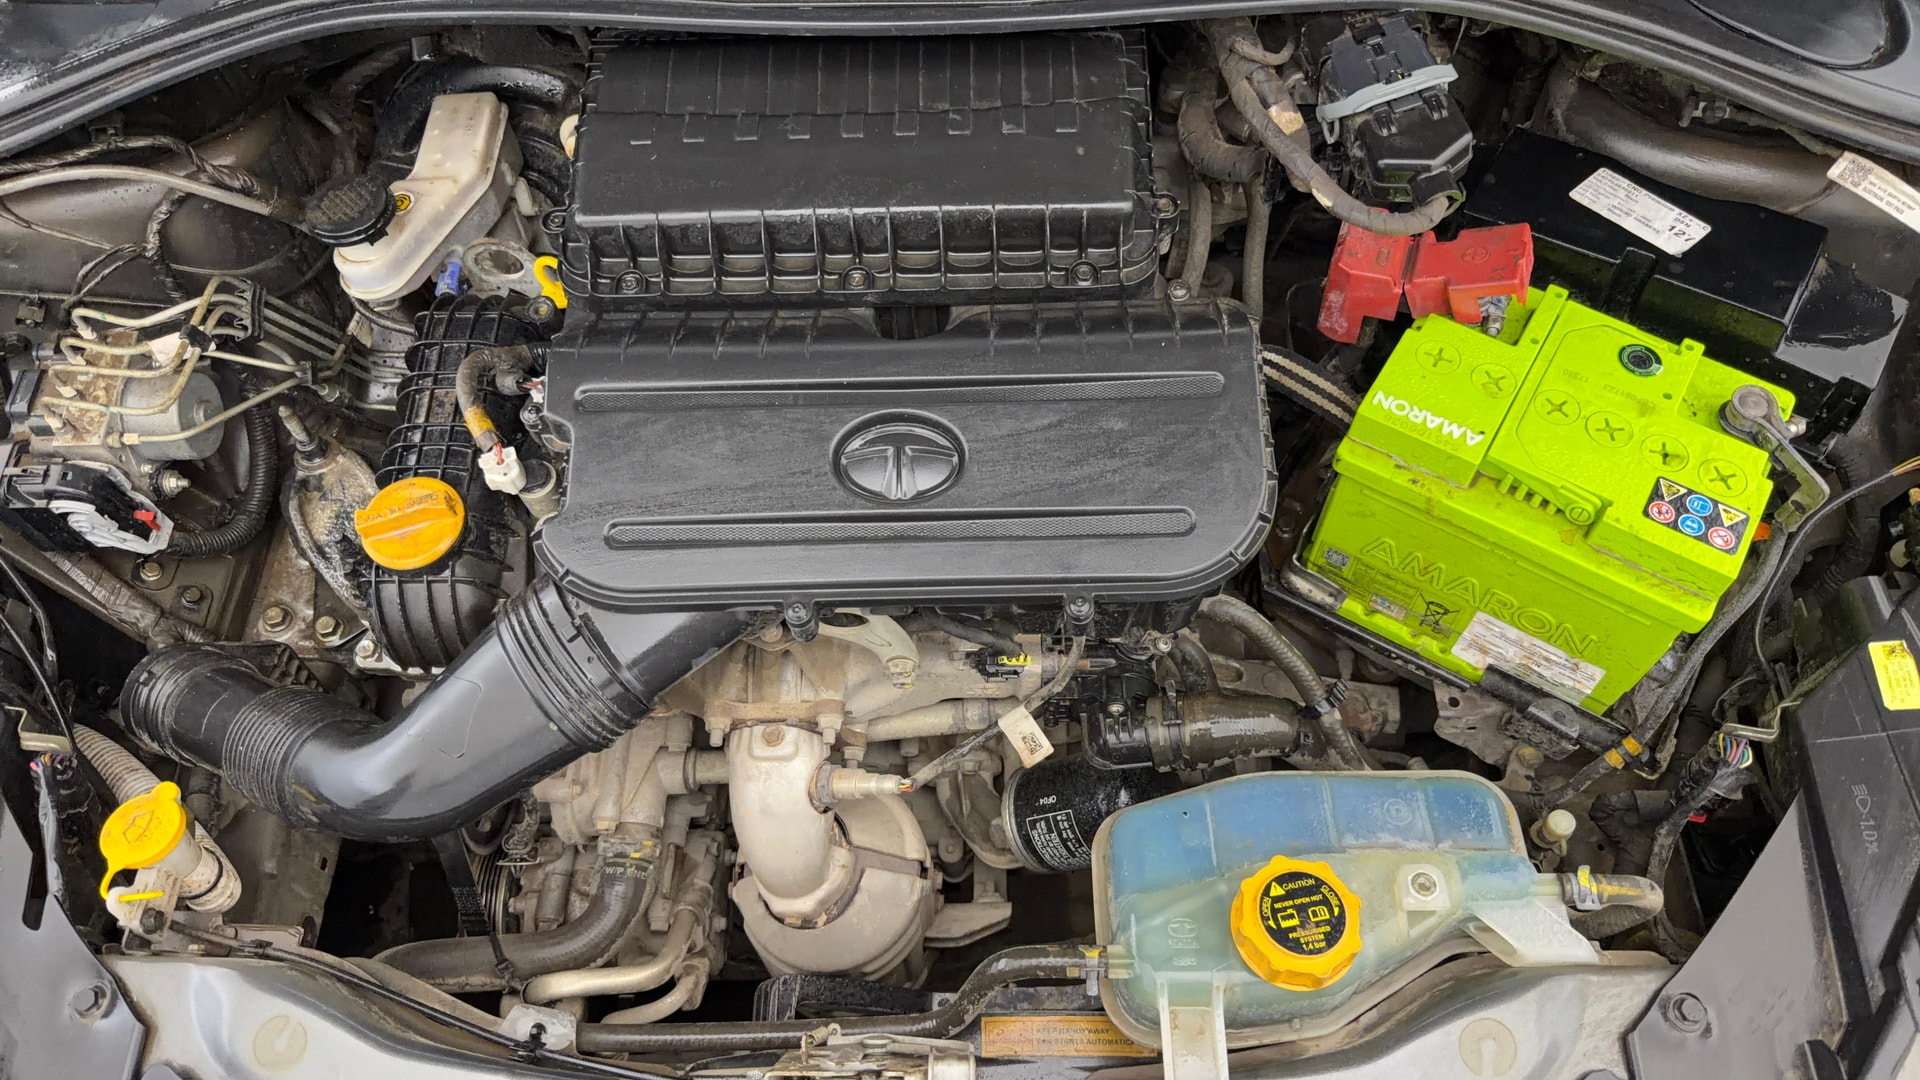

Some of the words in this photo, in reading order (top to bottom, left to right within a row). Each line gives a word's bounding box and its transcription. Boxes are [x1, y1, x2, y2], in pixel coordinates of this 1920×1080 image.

[1372, 390, 1485, 446] AMARON
[1361, 537, 1599, 657] AMARON
[1282, 879, 1316, 890] CAUTION
[1274, 900, 1293, 909] NEVER
[1294, 897, 1310, 905] OPEN
[1310, 894, 1323, 902] HOT
[1320, 884, 1340, 906] CLOSE
[1262, 896, 1270, 917] OPEN
[1288, 925, 1331, 939] PRESSURISED
[1299, 933, 1325, 944] SYSTEM
[1302, 942, 1314, 951] 1.4
